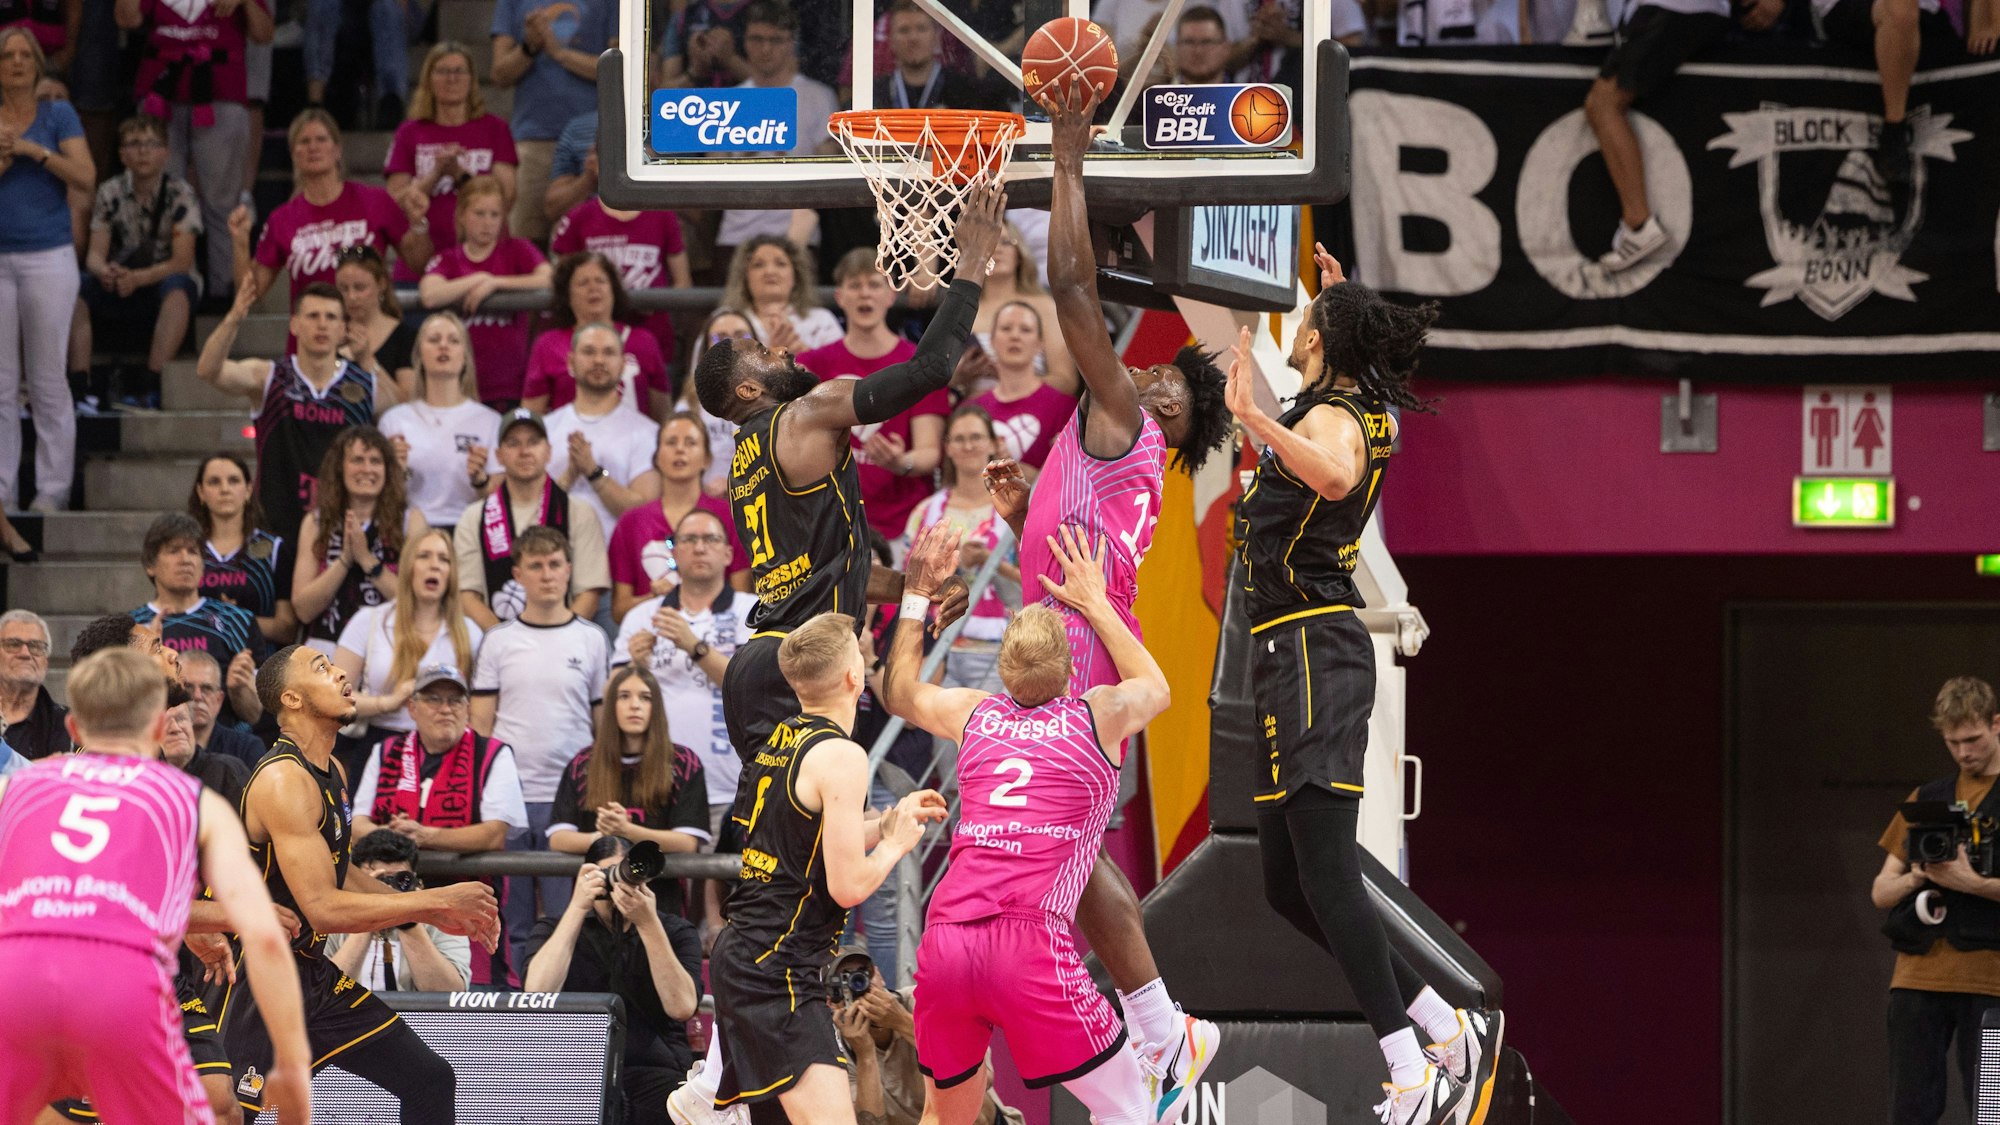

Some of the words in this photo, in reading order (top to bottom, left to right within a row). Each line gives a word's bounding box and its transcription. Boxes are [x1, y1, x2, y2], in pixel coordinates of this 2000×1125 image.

[660, 95, 741, 126] e@sy
[1154, 92, 1193, 107] e@sy
[1173, 103, 1216, 116] Credit
[697, 119, 788, 146] Credit
[1155, 117, 1216, 142] BBL
[1774, 118, 1851, 146] BLOCK
[1200, 205, 1280, 280] SINZIGER
[1805, 258, 1871, 284] BONN
[293, 402, 346, 425] BONN
[164, 636, 208, 652] ONN
[980, 710, 1070, 740] Griesel
[988, 757, 1034, 807] 2
[51, 793, 121, 864] 5
[449, 991, 500, 1009] VION
[507, 992, 560, 1009] TECH
